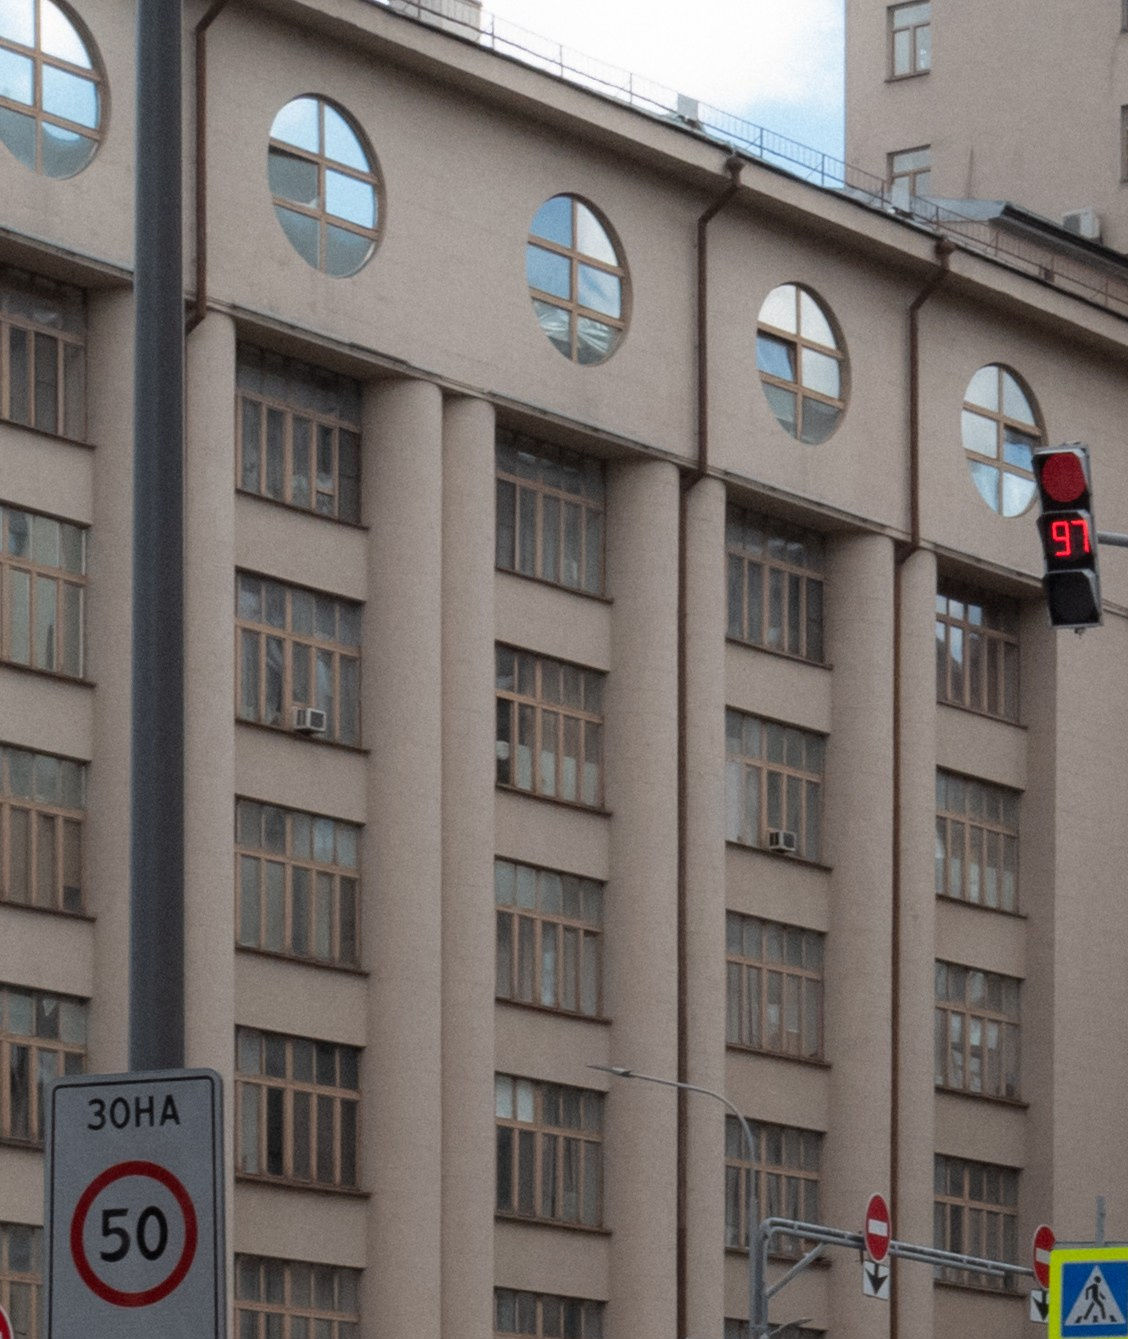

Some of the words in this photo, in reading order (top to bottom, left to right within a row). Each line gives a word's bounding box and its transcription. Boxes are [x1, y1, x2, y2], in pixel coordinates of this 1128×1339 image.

[1051, 519, 1090, 557] 97
[87, 1094, 181, 1131] ЗОНА
[99, 1205, 169, 1263] 50
